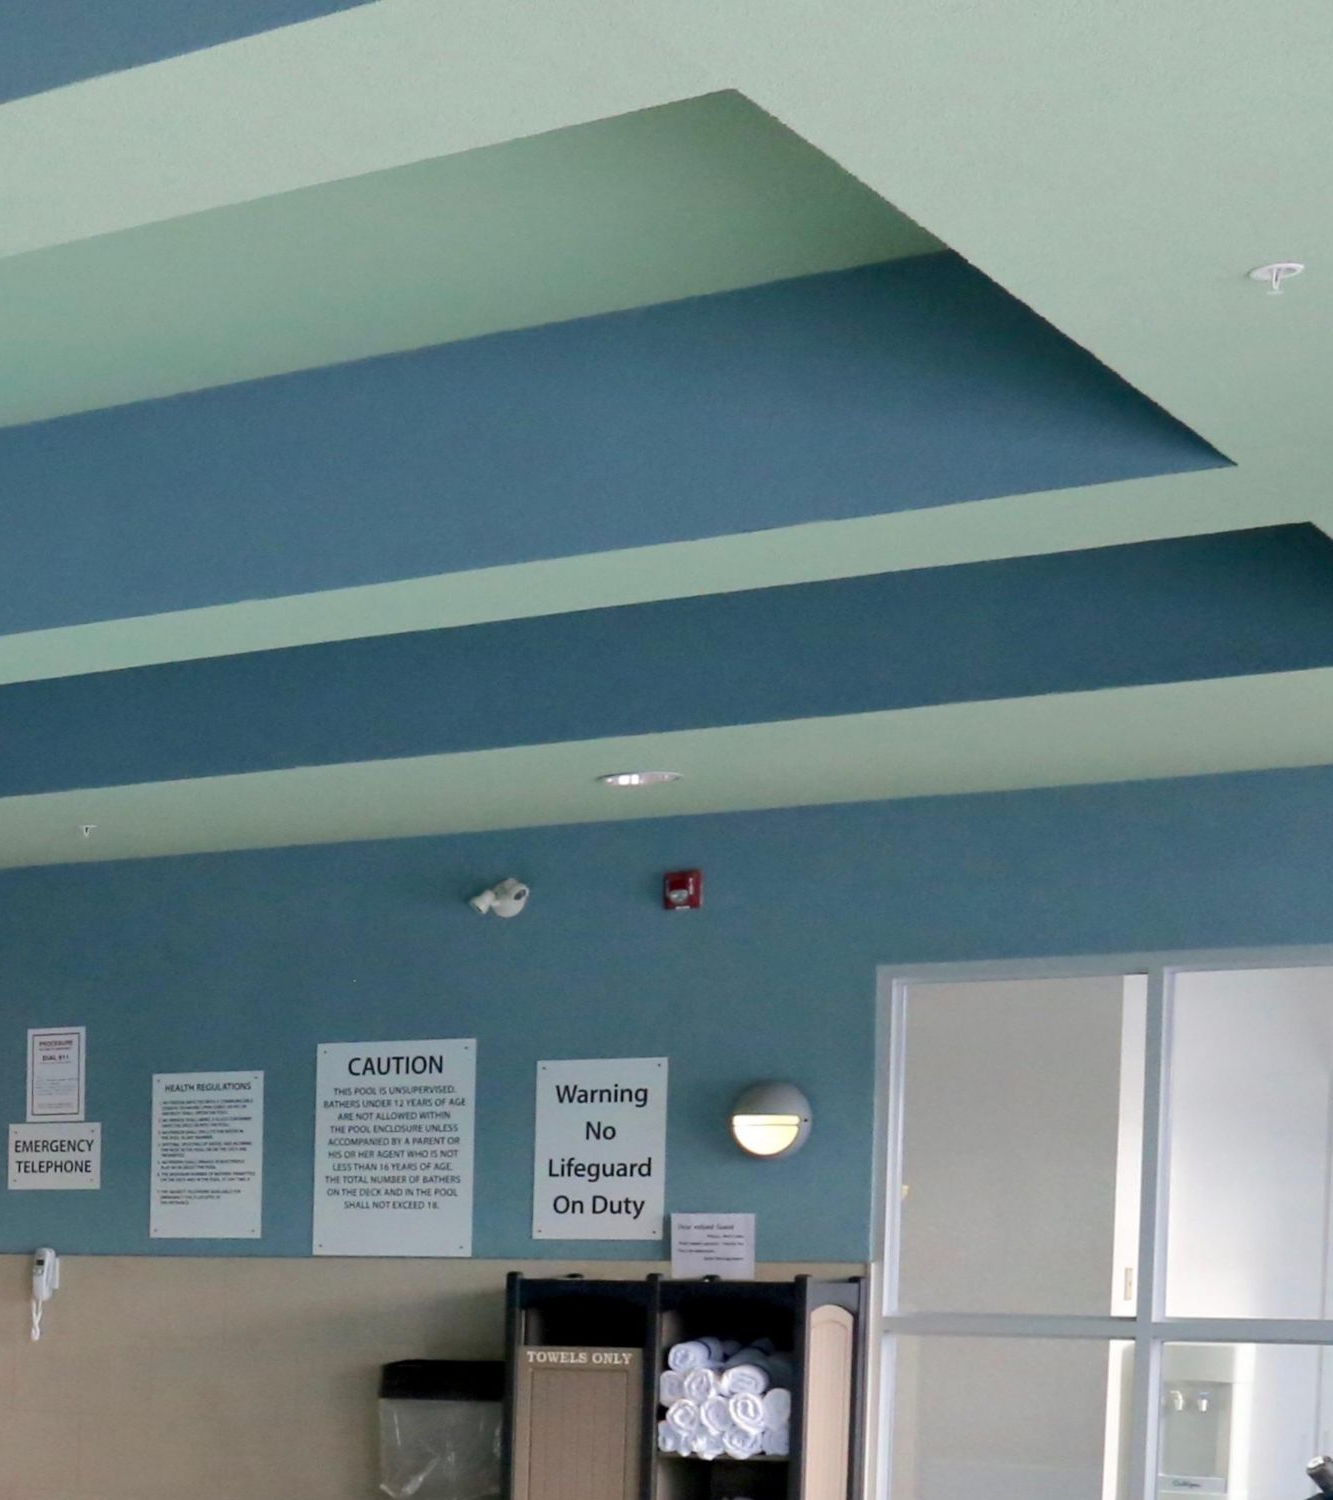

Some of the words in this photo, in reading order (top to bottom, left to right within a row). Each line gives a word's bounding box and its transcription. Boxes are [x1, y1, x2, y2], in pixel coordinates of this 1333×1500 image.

[348, 1055, 444, 1076] CAUTION
[165, 1083, 195, 1092] HEALTH
[196, 1082, 252, 1092] REGULATIONS
[334, 1088, 352, 1096] THIS
[354, 1087, 376, 1096] POOL
[379, 1086, 387, 1095] IS
[555, 1084, 649, 1108] Warning
[323, 1100, 360, 1109] BATHERS
[362, 1100, 391, 1108] UNDER
[407, 1098, 432, 1107] YEARS
[435, 1098, 446, 1106] OF
[448, 1098, 466, 1106] AGE
[338, 1112, 354, 1121] ARE
[356, 1112, 373, 1120] NOT
[375, 1112, 417, 1120] ALLOWED
[419, 1111, 451, 1119] WITHIN
[330, 1126, 345, 1134] THE
[348, 1125, 371, 1133] POOL
[373, 1124, 423, 1132] ENCLOSURE
[425, 1124, 459, 1132] UNLESS
[585, 1121, 616, 1140] No
[14, 1139, 95, 1153] EMERGENCY
[327, 1138, 389, 1146] ACCOMPANIED
[404, 1137, 411, 1145] A
[413, 1137, 445, 1145] PARENT
[447, 1136, 460, 1144] OR
[328, 1150, 342, 1159] HIS
[344, 1150, 356, 1159] OR
[357, 1150, 374, 1158] HER
[377, 1150, 405, 1158] AGENT
[407, 1150, 428, 1158] WHO
[430, 1150, 438, 1158] IS
[440, 1150, 459, 1158] NOT
[15, 1160, 92, 1173] TELEPHONE
[333, 1163, 351, 1172] LESS
[354, 1163, 377, 1171] THAN
[392, 1163, 418, 1171] YEARS
[420, 1162, 431, 1171] OF
[547, 1157, 652, 1182] Lifeguard
[325, 1176, 339, 1184] THE
[343, 1176, 368, 1184] TOTAL
[422, 1176, 461, 1184] BATHERS
[327, 1188, 339, 1196] ON
[341, 1188, 356, 1196] THE
[359, 1188, 381, 1196] DECK
[384, 1188, 403, 1196] AND
[405, 1188, 413, 1196] IN
[415, 1188, 432, 1196] THE
[434, 1188, 458, 1196] POOL
[344, 1201, 370, 1209] SHALL
[372, 1201, 390, 1209] NOT
[392, 1201, 425, 1209] EXCEED
[552, 1195, 584, 1215] On
[591, 1195, 645, 1220] Duty
[527, 1351, 588, 1363] TOWELS
[591, 1353, 632, 1365] ONLY
